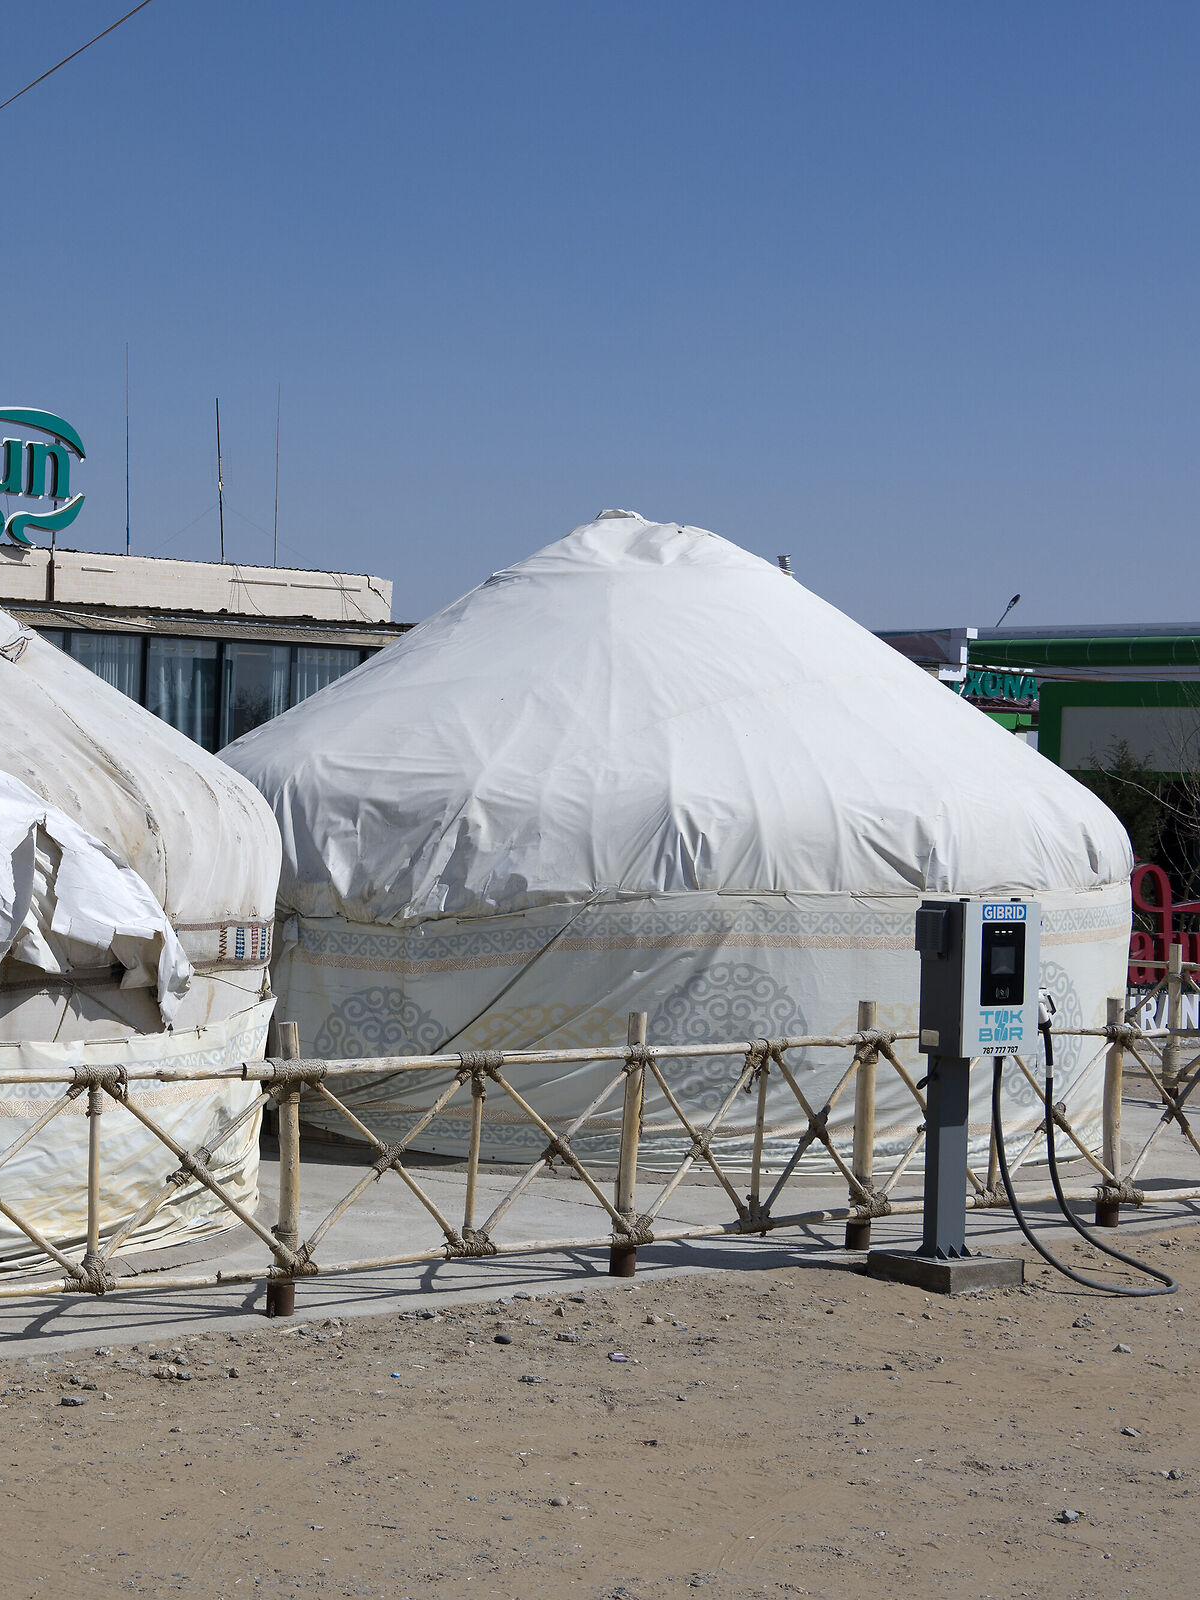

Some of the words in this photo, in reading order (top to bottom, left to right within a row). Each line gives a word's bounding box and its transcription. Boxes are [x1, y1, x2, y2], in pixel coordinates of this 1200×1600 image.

[951, 668, 1039, 700] XONA
[984, 905, 1025, 920] GIBRID
[979, 1008, 1024, 1025] TOK
[978, 1026, 1024, 1043] BOR
[982, 1046, 994, 1055] 787
[995, 1046, 1007, 1054] 777
[1007, 1045, 1019, 1054] 787
